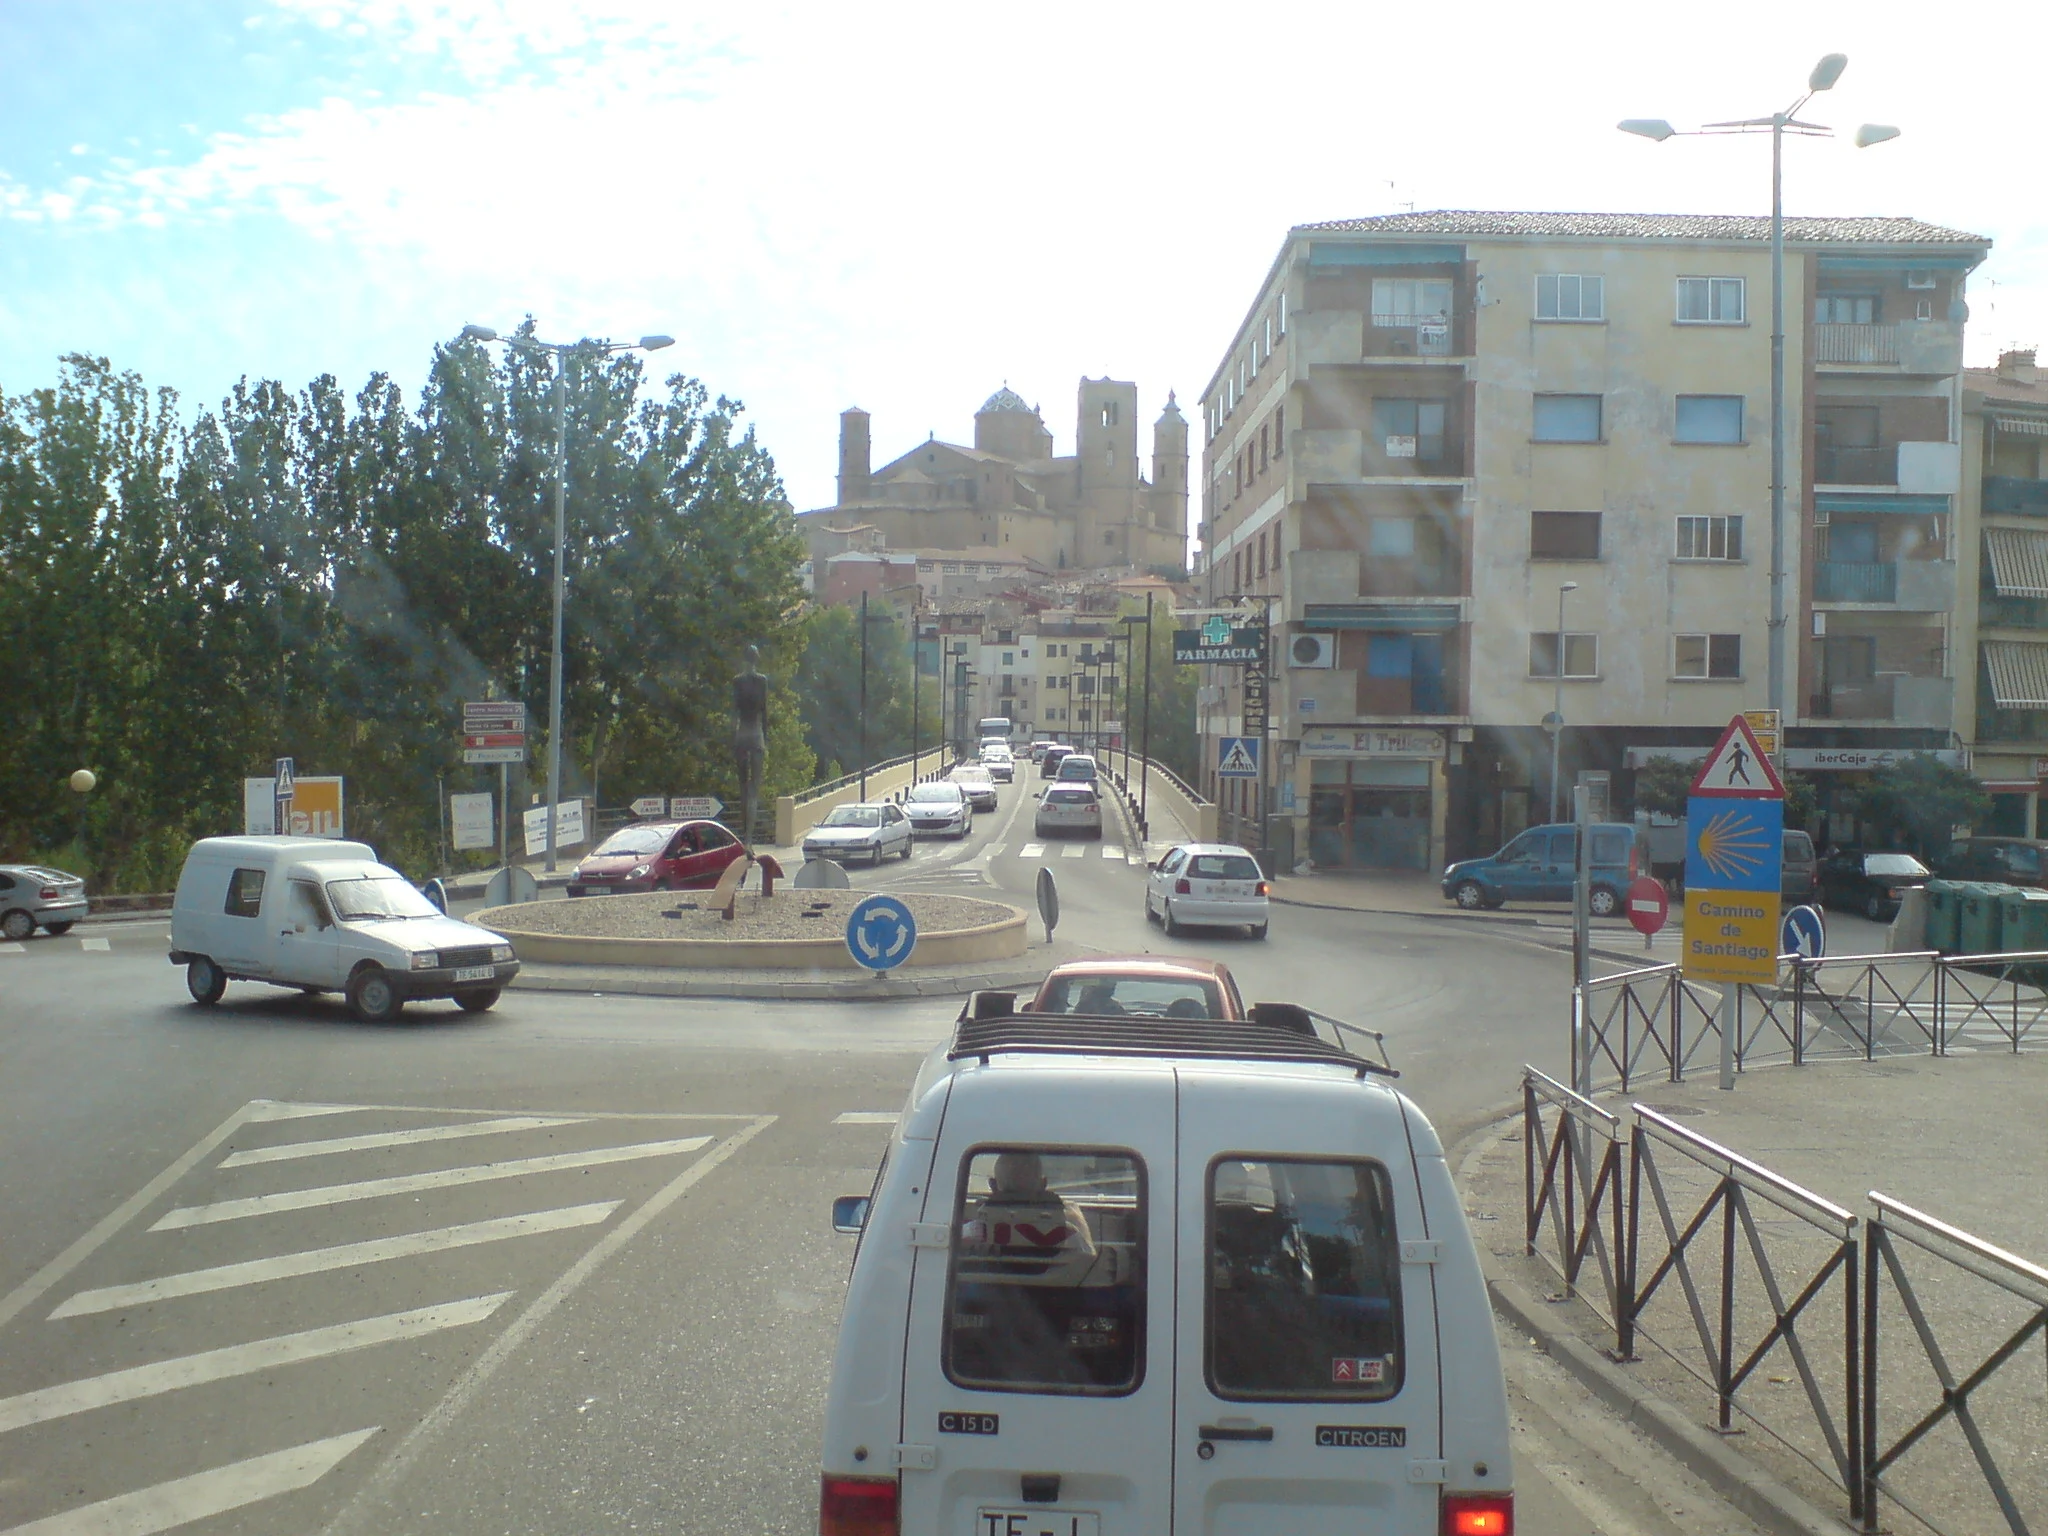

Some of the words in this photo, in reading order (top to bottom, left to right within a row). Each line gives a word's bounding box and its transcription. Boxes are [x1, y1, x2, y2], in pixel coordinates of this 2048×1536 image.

[1176, 648, 1258, 660] FARMACIA
[1699, 902, 1765, 919] Camino
[1720, 923, 1741, 936] de
[1692, 940, 1769, 960] Santiago
[942, 1416, 955, 1430] C
[961, 1417, 977, 1431] 15
[982, 1418, 995, 1432] D
